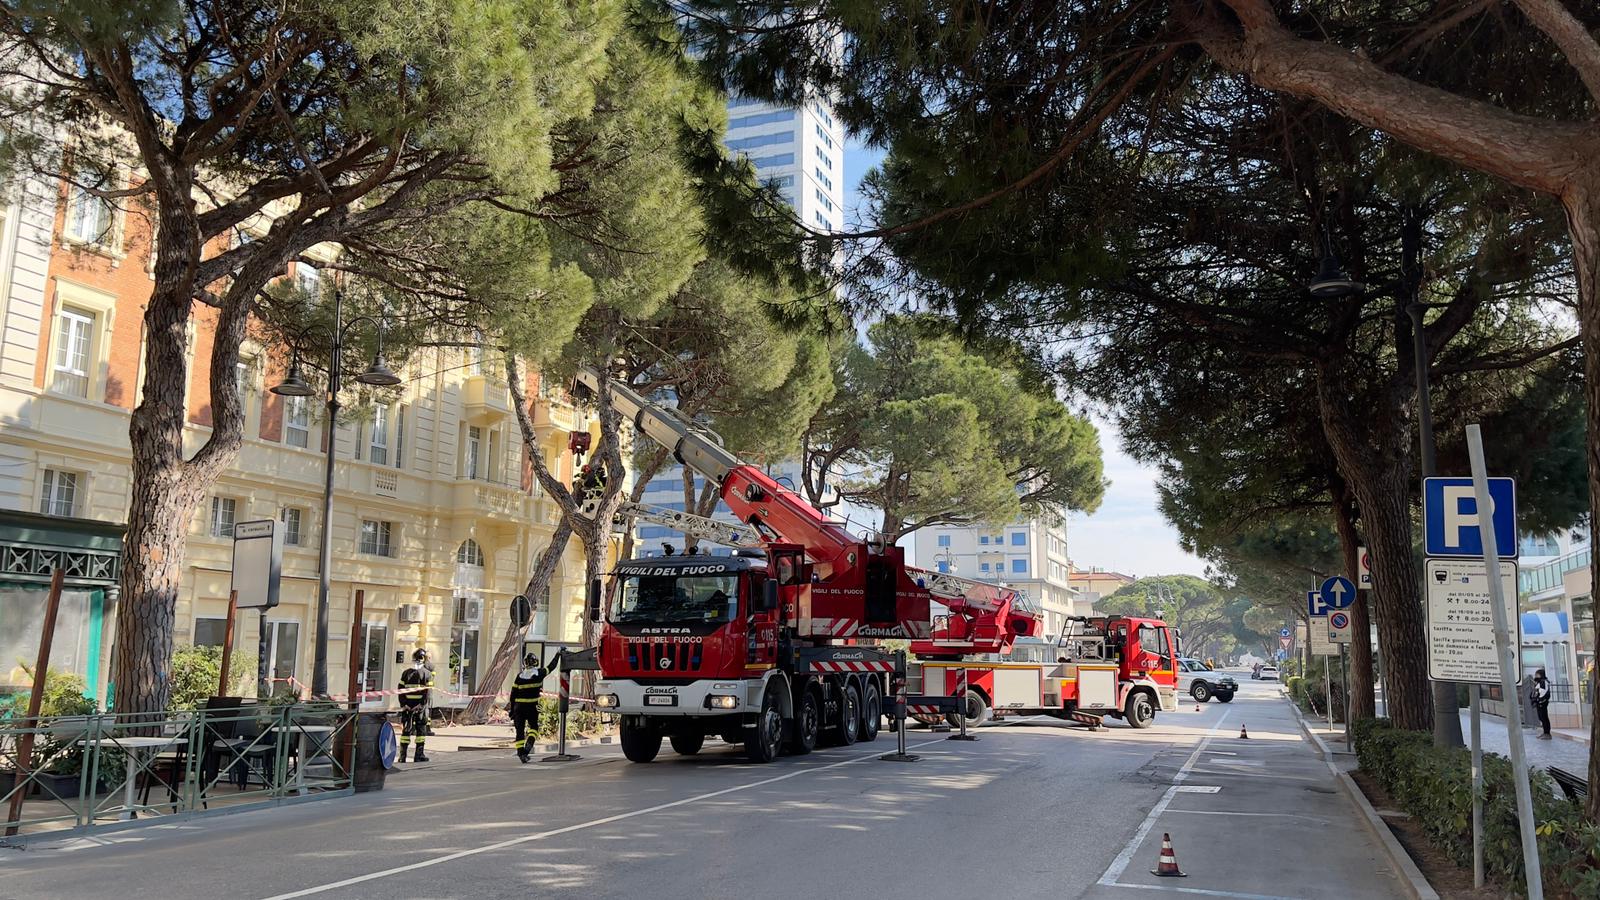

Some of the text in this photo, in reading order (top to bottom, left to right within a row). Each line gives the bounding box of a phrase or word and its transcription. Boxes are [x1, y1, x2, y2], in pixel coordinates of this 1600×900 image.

[1443, 485, 1495, 547] P
[620, 565, 726, 576] VIGILI DEL FUOCO
[858, 624, 902, 636] CORMACH
[628, 636, 703, 644] VIGILI DEL FUOCO
[832, 651, 864, 660] CORMACH
[645, 686, 678, 694] CORMACH
